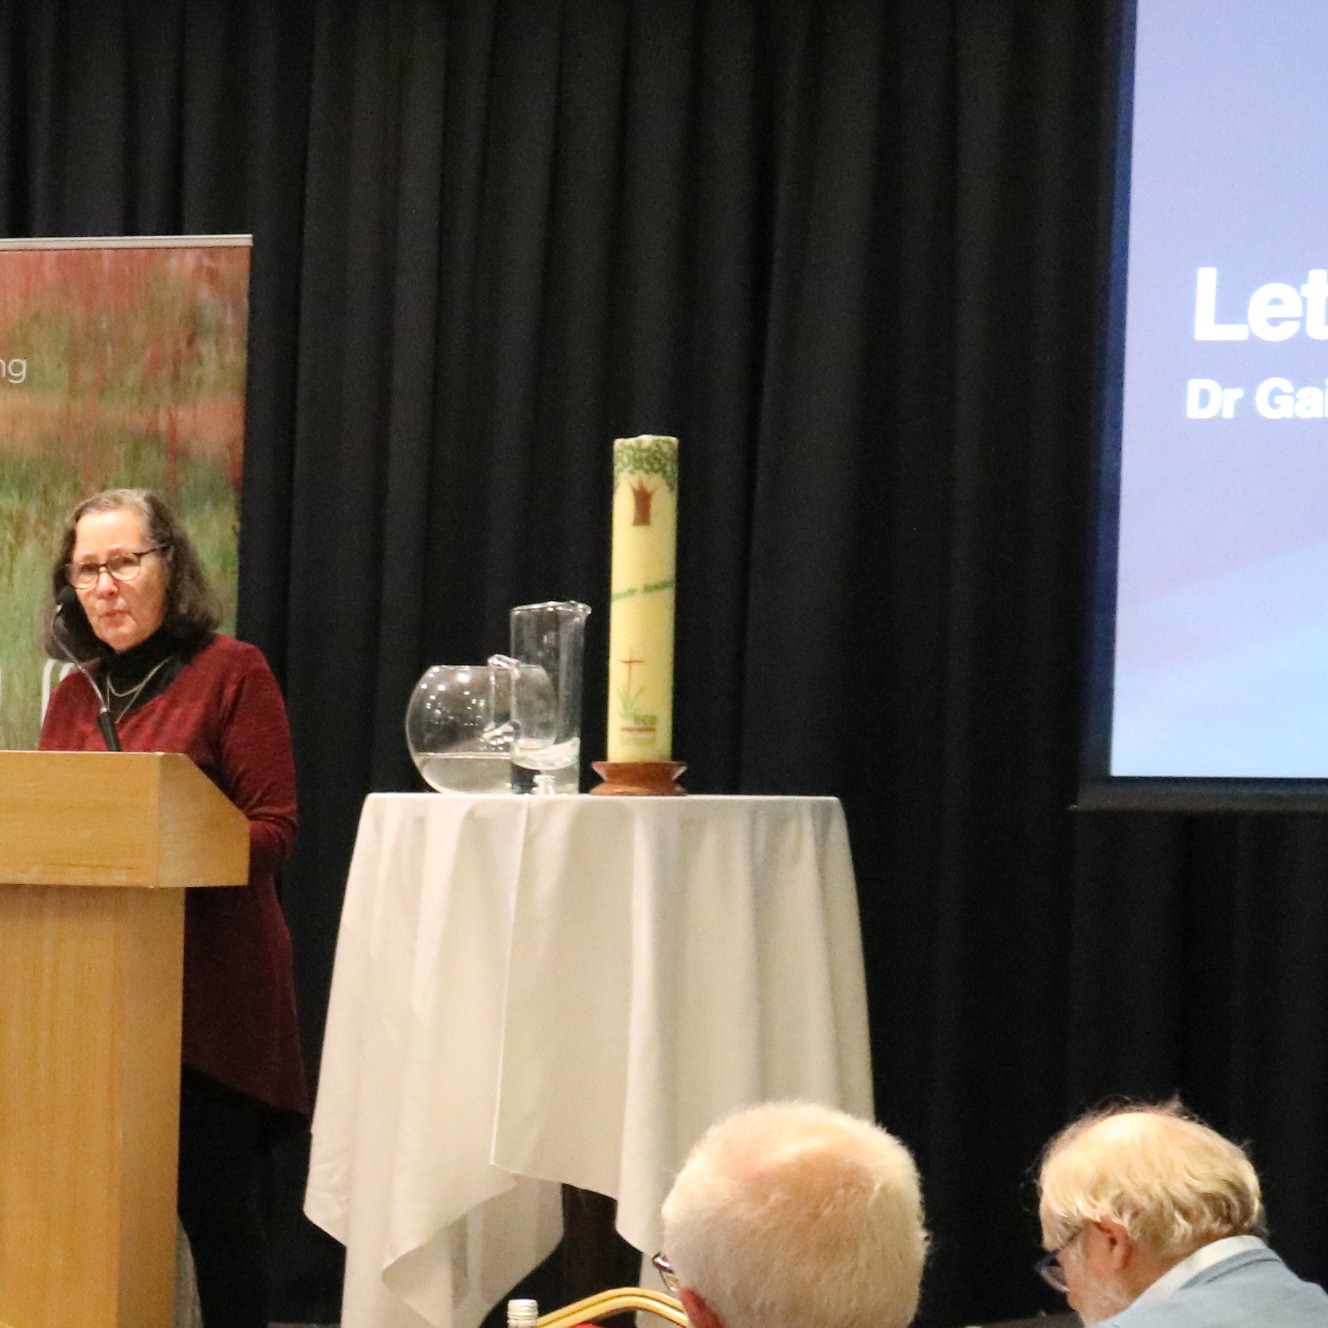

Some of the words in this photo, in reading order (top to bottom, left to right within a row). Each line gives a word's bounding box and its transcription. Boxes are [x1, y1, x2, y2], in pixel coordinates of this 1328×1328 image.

[1194, 267, 1328, 342] Let
[1186, 378, 1243, 419] Dr
[1255, 377, 1328, 419] Ga
